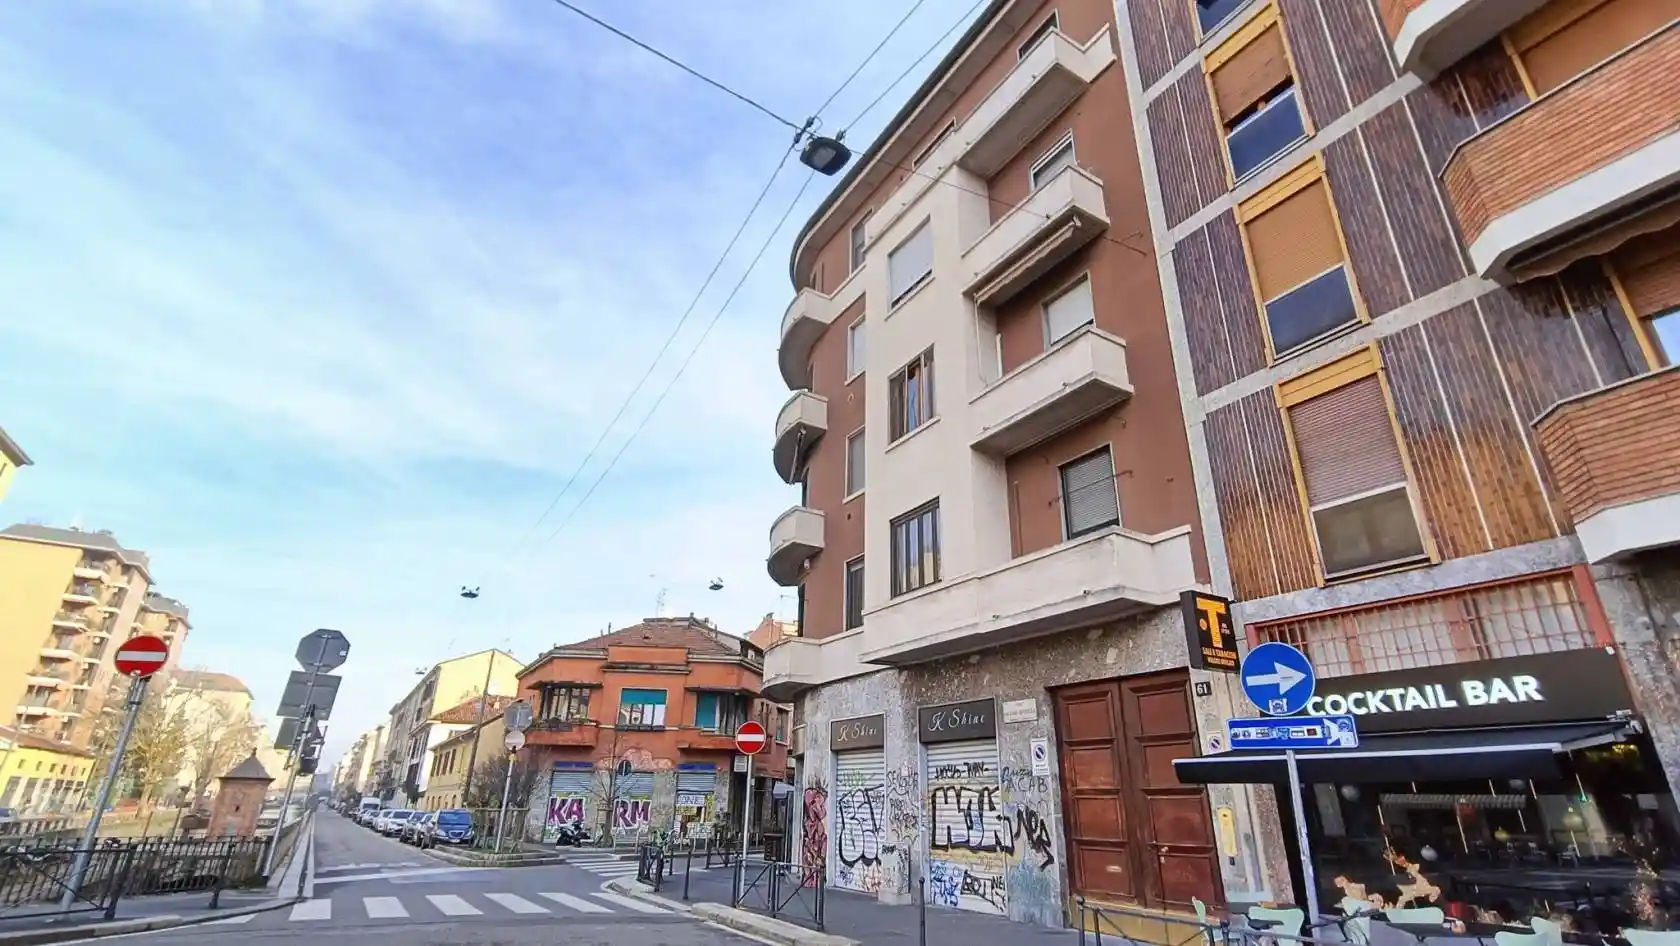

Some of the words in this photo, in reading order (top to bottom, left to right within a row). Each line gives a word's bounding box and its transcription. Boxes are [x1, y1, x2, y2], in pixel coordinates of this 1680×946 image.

[1197, 683, 1208, 695] 61
[1306, 683, 1459, 717] COCKTAIL
[1461, 674, 1544, 706] BAR
